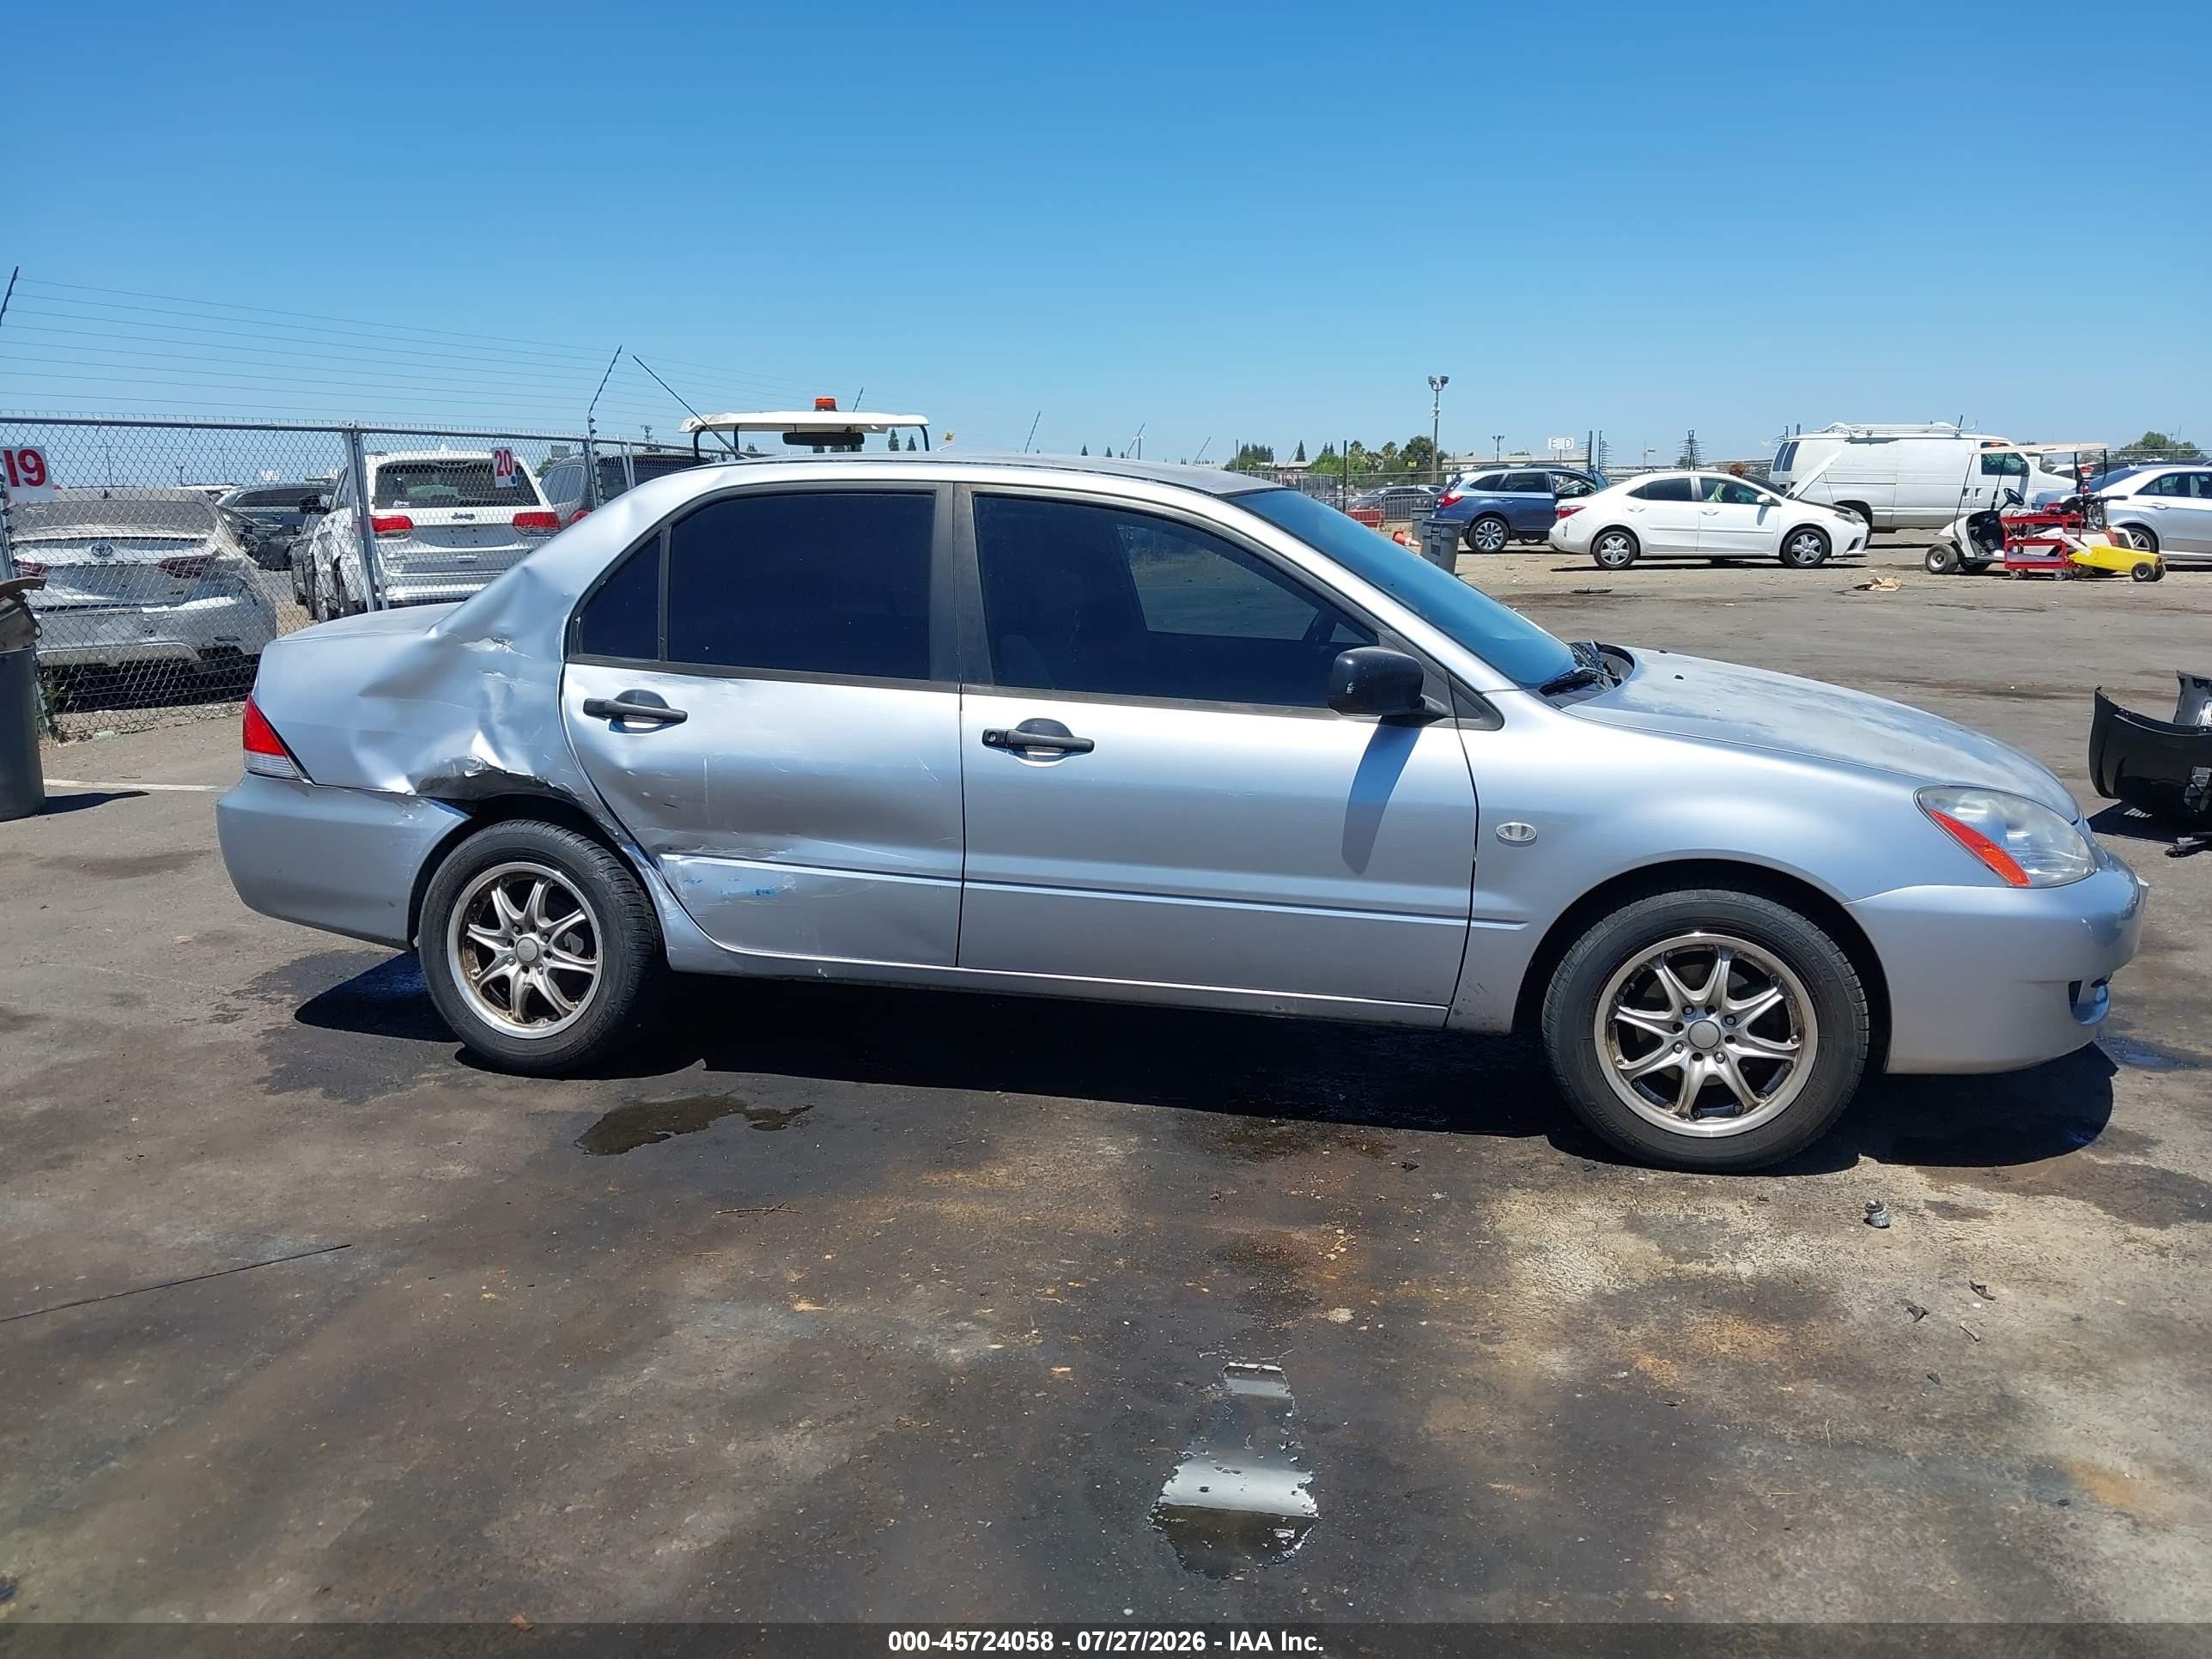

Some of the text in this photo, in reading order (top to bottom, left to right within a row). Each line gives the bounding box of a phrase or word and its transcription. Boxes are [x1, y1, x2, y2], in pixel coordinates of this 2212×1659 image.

[1564, 438, 1572, 449] D
[3, 448, 46, 487] 19
[494, 449, 514, 477] 20
